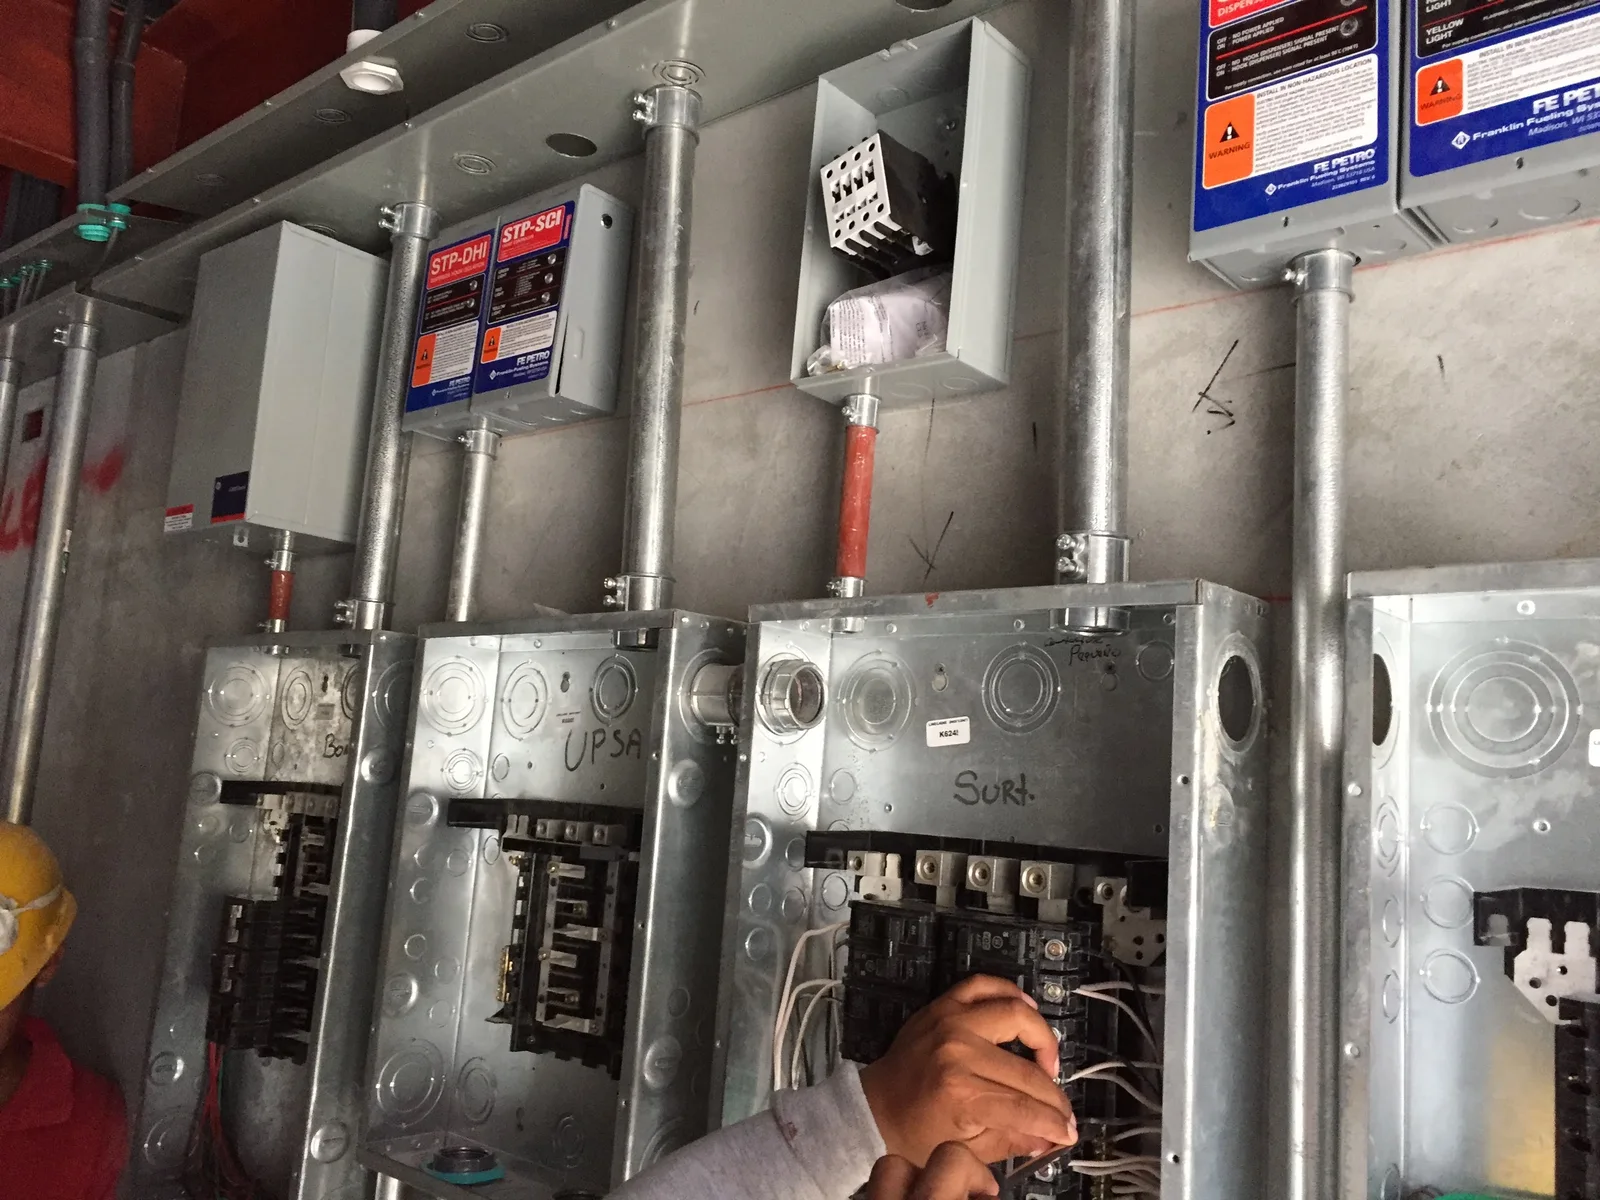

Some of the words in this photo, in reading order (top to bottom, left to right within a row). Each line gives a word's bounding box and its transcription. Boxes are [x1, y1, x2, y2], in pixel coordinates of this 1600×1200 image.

[1426, 0, 1452, 13] LIGHT
[1232, 31, 1241, 39] NO
[1242, 25, 1261, 35] POWER
[1262, 17, 1285, 29] APPLIED
[1232, 34, 1252, 45] POWER
[1253, 26, 1274, 38] APPLIED
[1426, 18, 1464, 36] YELLOW
[1426, 30, 1454, 44] LIGHT
[1231, 62, 1248, 73] HOOK
[1282, 44, 1303, 56] SIGNAL
[1303, 36, 1328, 49] PRESENT
[1242, 52, 1259, 62] HOOK
[1293, 32, 1314, 46] SIGNAL
[1315, 25, 1340, 40] PRESENT
[1479, 46, 1504, 58] INSTALL
[1256, 87, 1278, 99] INSTALL
[1341, 58, 1373, 72] LOCATION
[1420, 93, 1462, 111] WARNING
[1533, 94, 1560, 115] FE
[1563, 83, 1600, 107] PET
[1472, 121, 1524, 141] Franklin
[1526, 108, 1574, 126] Fueling
[1209, 142, 1250, 160] WARNING
[1314, 160, 1330, 174] FE
[1332, 149, 1375, 169] PETRO
[1278, 178, 1309, 190] Franklin
[1310, 170, 1338, 182] Fueling
[1339, 160, 1375, 173] Systems
[503, 209, 562, 243] STP-SCI
[431, 241, 487, 275] STP-DHI
[517, 356, 526, 366] FE
[526, 350, 550, 363] PETRO
[564, 728, 642, 772] UPSA
